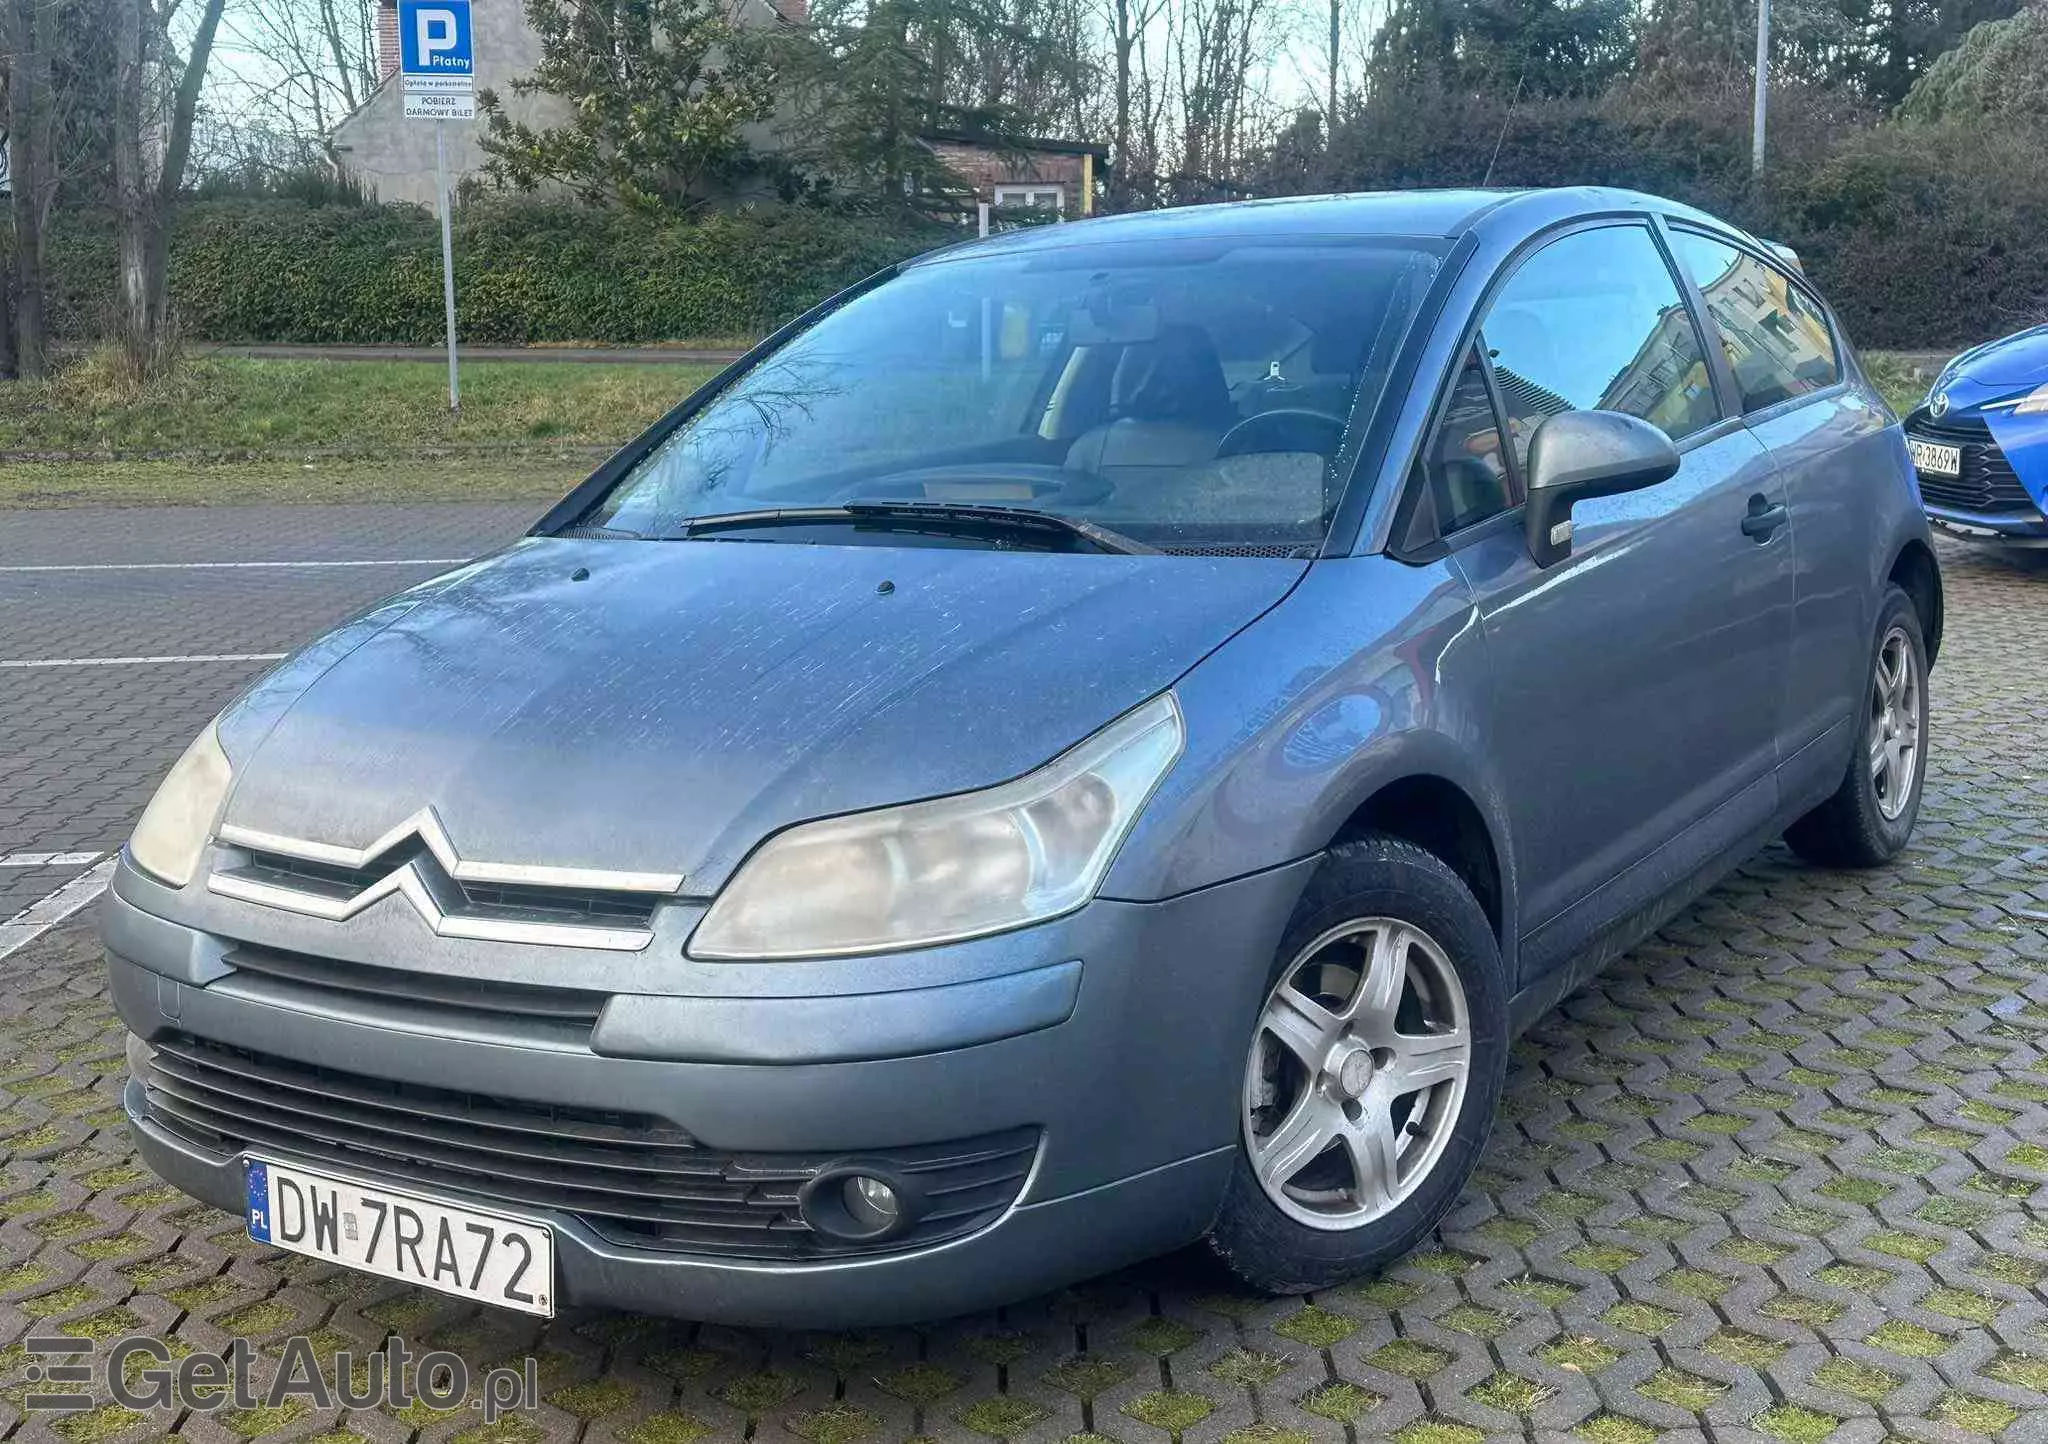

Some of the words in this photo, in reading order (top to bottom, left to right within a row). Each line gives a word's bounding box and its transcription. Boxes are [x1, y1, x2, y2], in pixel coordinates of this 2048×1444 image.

[416, 9, 457, 66] P
[432, 55, 470, 69] Płatny
[421, 96, 457, 105] POBIERZ
[406, 107, 450, 117] DARMOWY
[451, 108, 472, 117] BILET
[251, 1208, 268, 1230] PL
[276, 1176, 338, 1255] DW
[360, 1196, 534, 1305] 7RA72
